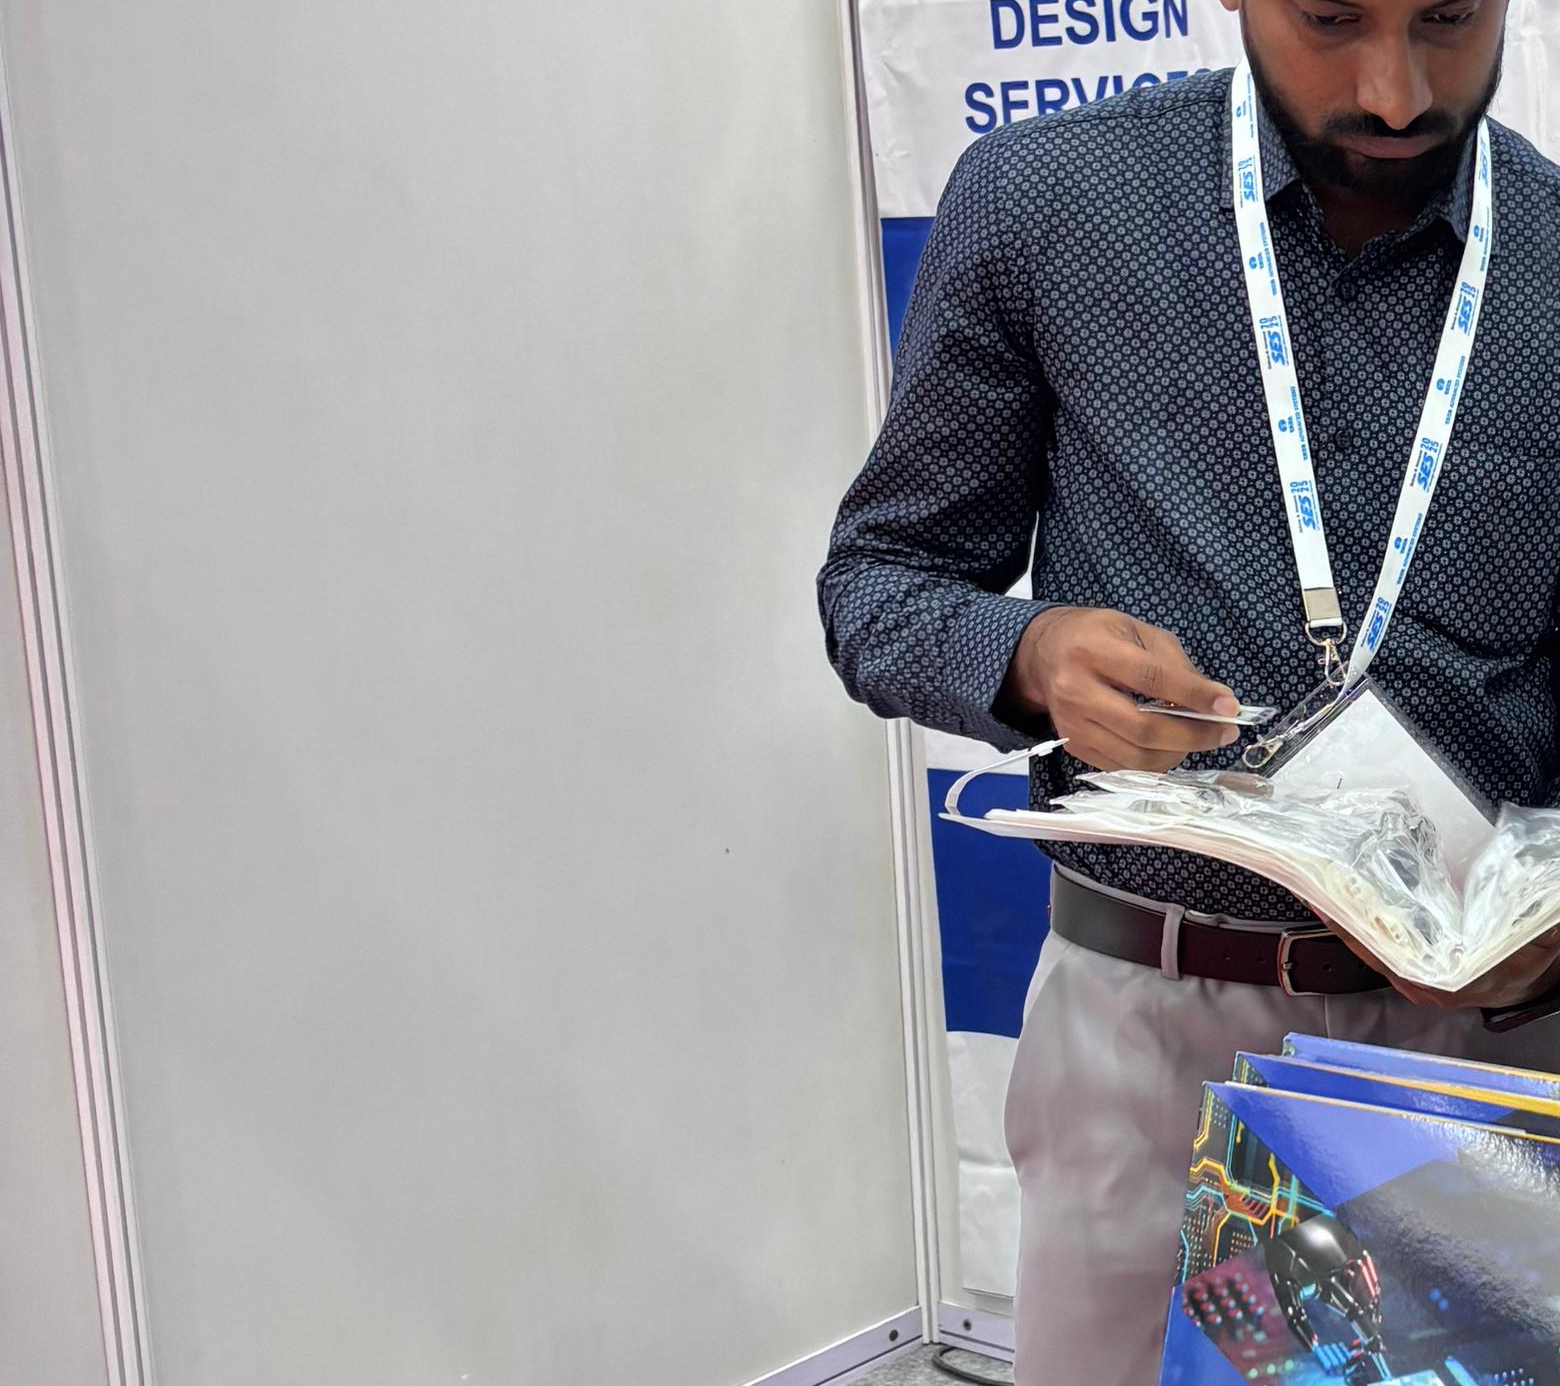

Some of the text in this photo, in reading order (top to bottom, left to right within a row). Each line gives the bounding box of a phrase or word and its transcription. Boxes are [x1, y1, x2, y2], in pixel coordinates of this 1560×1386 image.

[1458, 299, 1472, 334] SES
[1268, 331, 1285, 366] SES
[1418, 454, 1434, 489] SES
[1301, 498, 1316, 530] SES
[1367, 616, 1383, 651] SES
